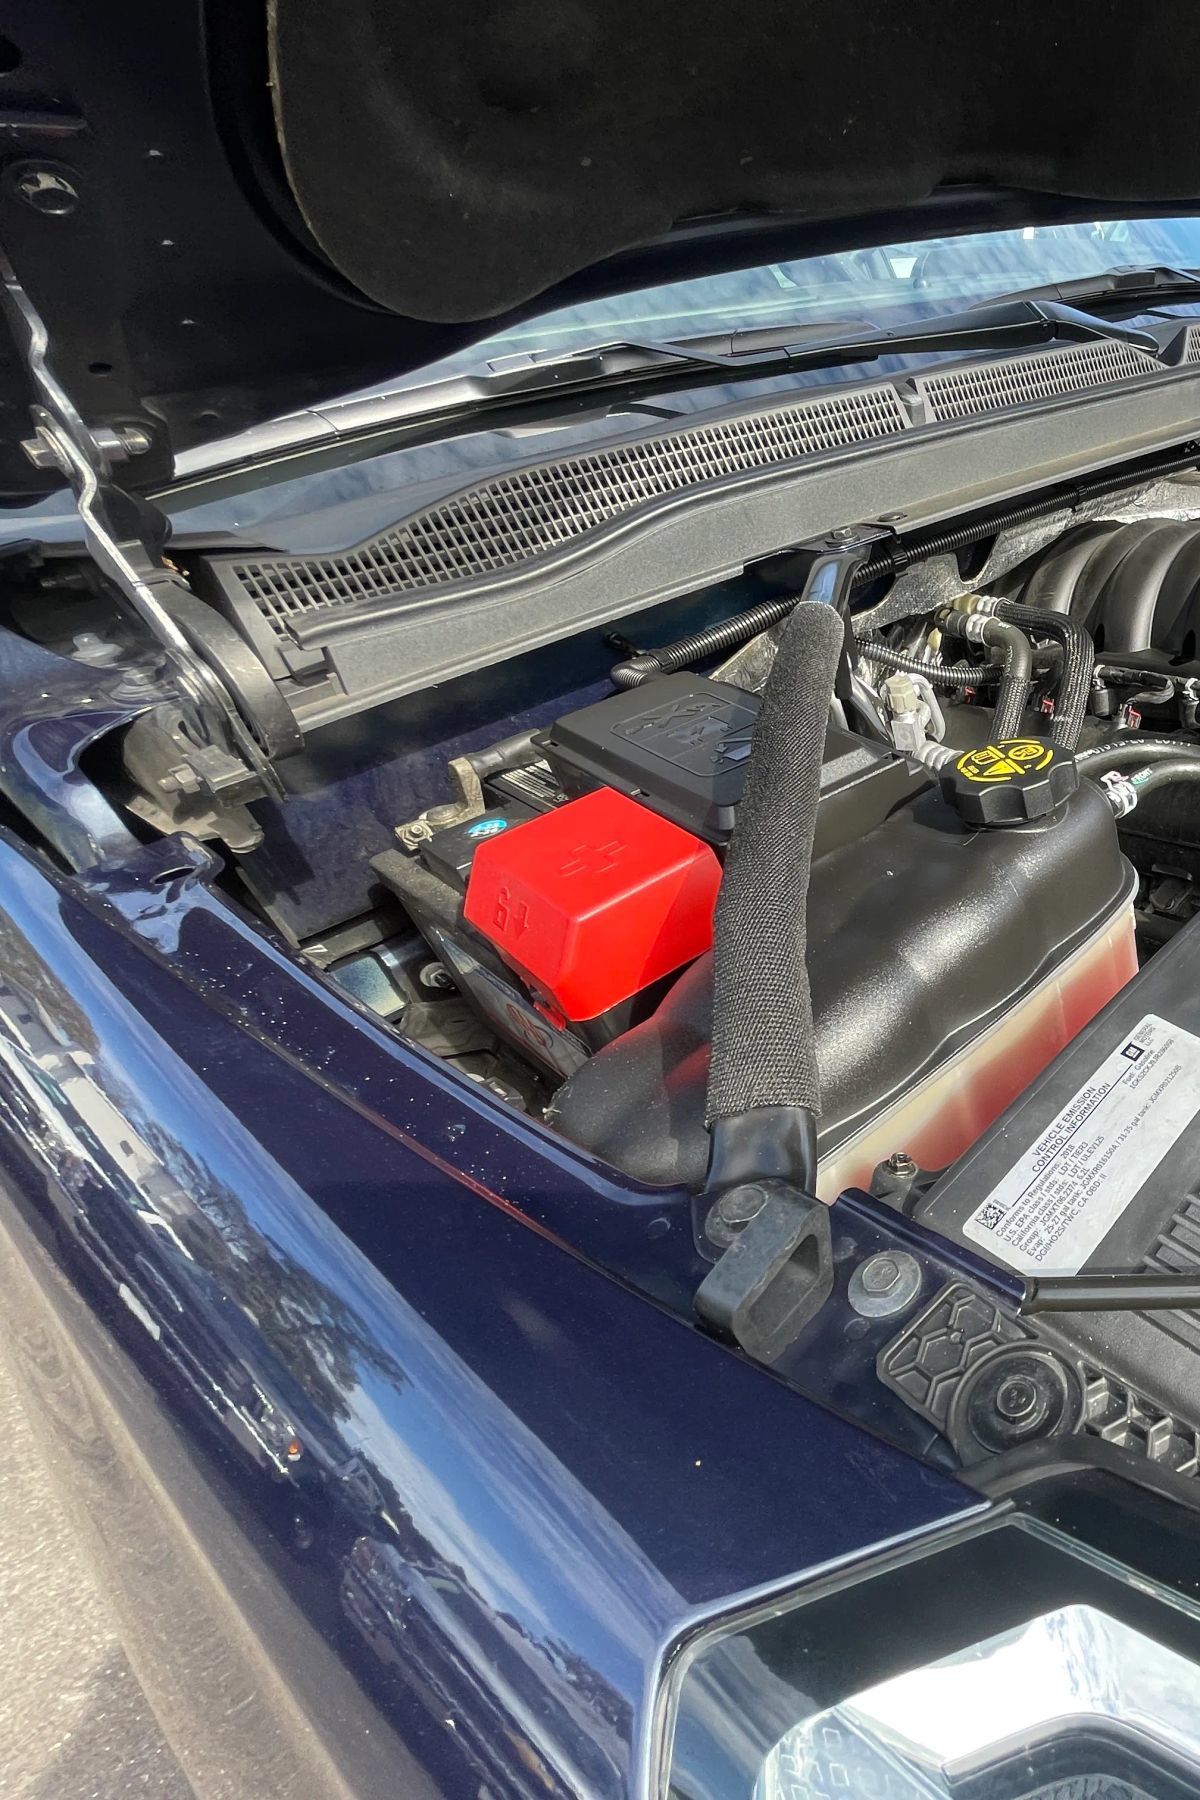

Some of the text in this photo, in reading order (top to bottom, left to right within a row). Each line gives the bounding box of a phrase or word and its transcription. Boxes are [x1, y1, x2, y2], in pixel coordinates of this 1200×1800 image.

[1031, 1082, 1111, 1173] CONTROL INFORMATION
[1032, 1085, 1096, 1157] VEHICLE EMISSION
[995, 1205, 1025, 1237] Conforms
[1021, 1196, 1031, 1206] to
[1027, 1160, 1063, 1199] Regulations:
[1060, 1143, 1075, 1159] 2018
[1003, 1226, 1018, 1242] U.S.
[1015, 1212, 1030, 1228] EPA
[1026, 1195, 1044, 1214] class
[1043, 1176, 1060, 1193] stds:
[1058, 1161, 1072, 1175] LDT
[1071, 1140, 1089, 1159] TIER3
[1010, 1213, 1041, 1247] California
[1036, 1196, 1054, 1216] class
[1053, 1178, 1069, 1195] stds:
[1067, 1162, 1082, 1178] LDT
[1080, 1134, 1106, 1162] ULEV125
[1018, 1227, 1042, 1252] Group:
[1076, 1165, 1090, 1180] 6.2L
[1026, 1235, 1046, 1257] Evap:
[1043, 1214, 1063, 1234] 25-27
[1058, 1203, 1072, 1217] gal
[1130, 1116, 1142, 1127] gal
[1076, 1195, 1089, 1208] CA
[1085, 1177, 1103, 1197] OBD:
